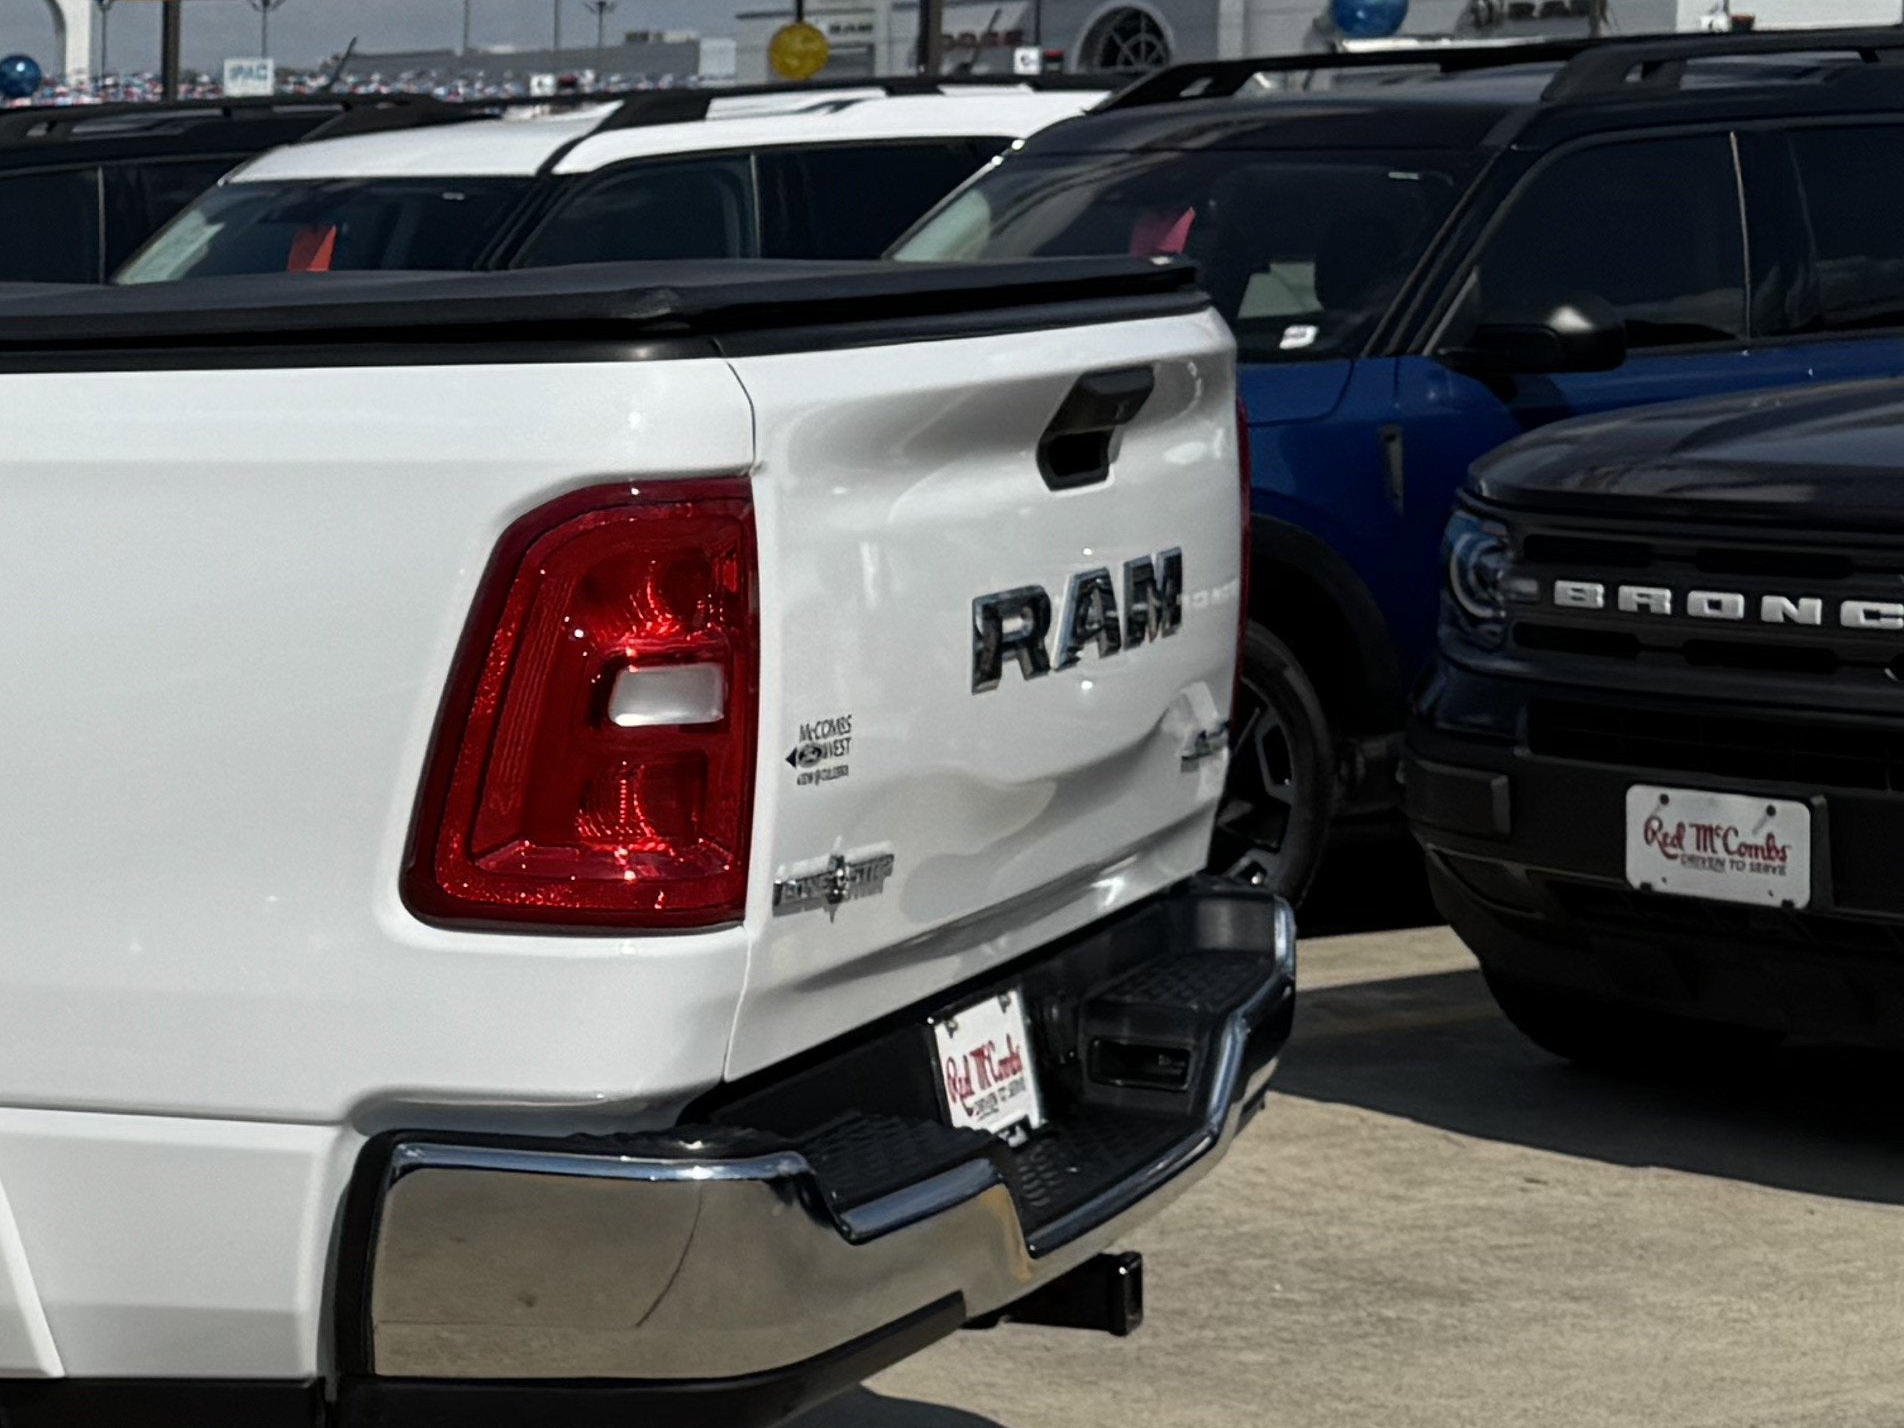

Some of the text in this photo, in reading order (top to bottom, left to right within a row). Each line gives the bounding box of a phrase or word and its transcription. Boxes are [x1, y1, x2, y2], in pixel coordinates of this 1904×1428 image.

[971, 546, 1183, 696] RAM
[1644, 815, 1789, 863] Red McCombs
[946, 1054, 976, 1117] Red
